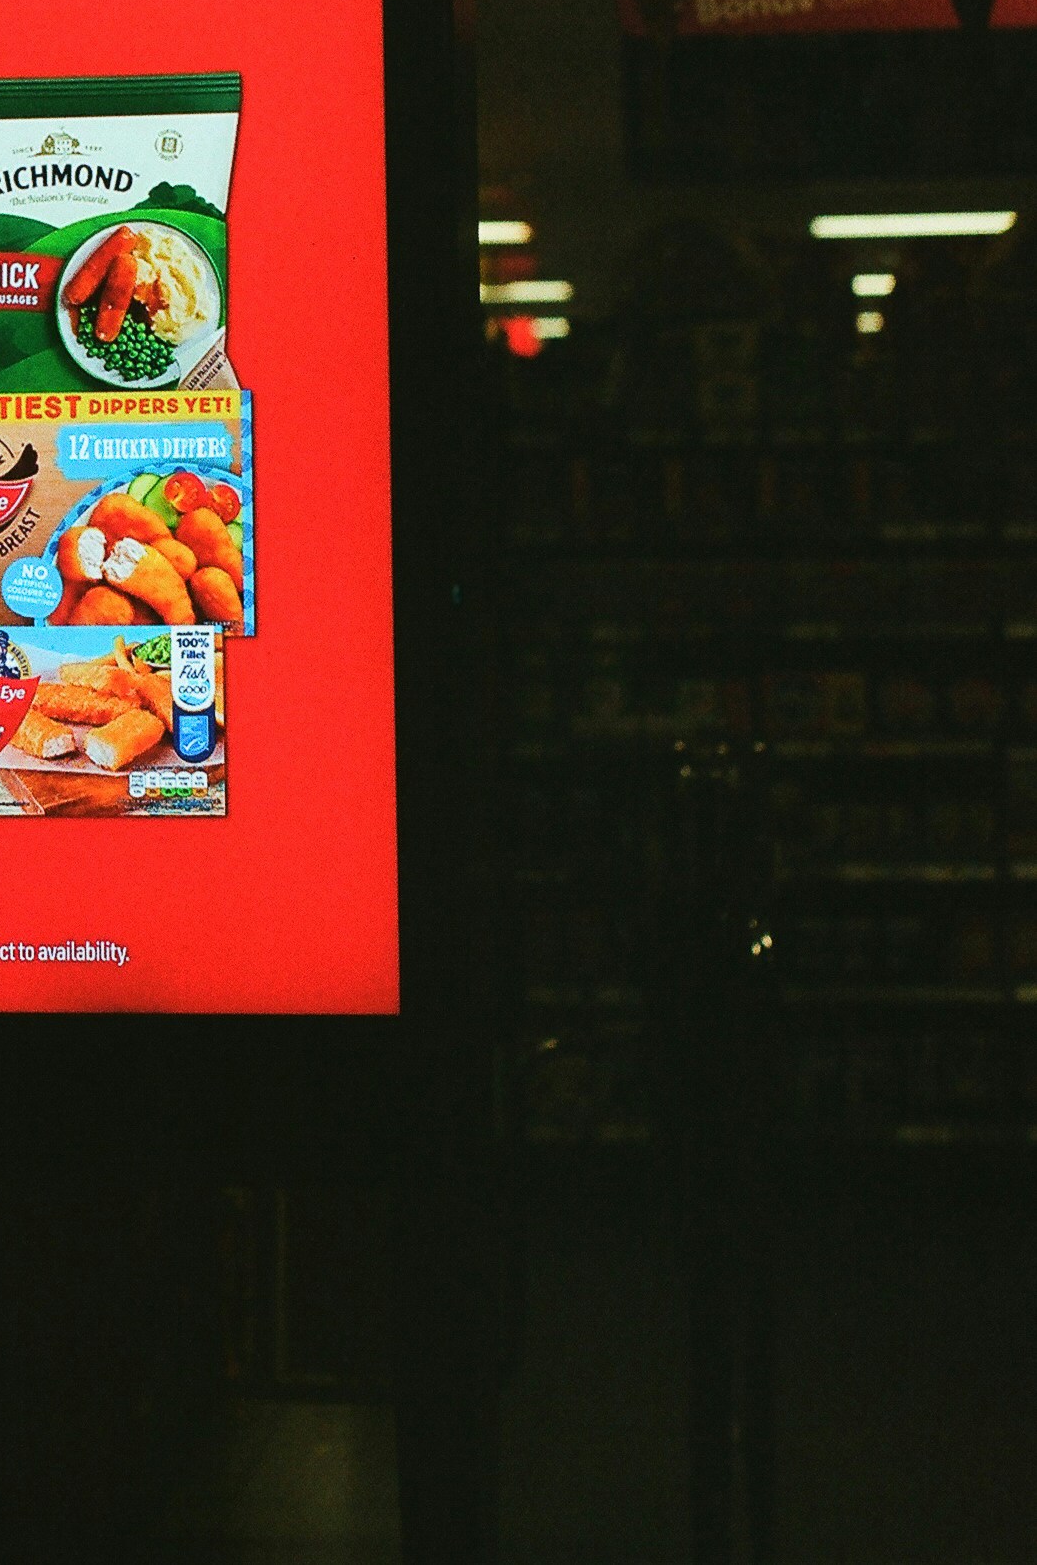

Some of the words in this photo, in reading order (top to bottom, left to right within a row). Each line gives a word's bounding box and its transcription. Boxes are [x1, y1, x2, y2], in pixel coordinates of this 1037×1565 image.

[89, 398, 179, 415] DIPPERS
[184, 396, 231, 414] YET!
[94, 437, 160, 460] CHICKEN
[163, 436, 227, 459] DIPPERS
[22, 564, 48, 581] NO
[176, 638, 209, 648] 100%
[181, 650, 206, 659] fillet
[179, 664, 206, 680] Fish
[178, 685, 207, 694] GOOD
[18, 942, 35, 961] to
[38, 941, 130, 967] availability.
